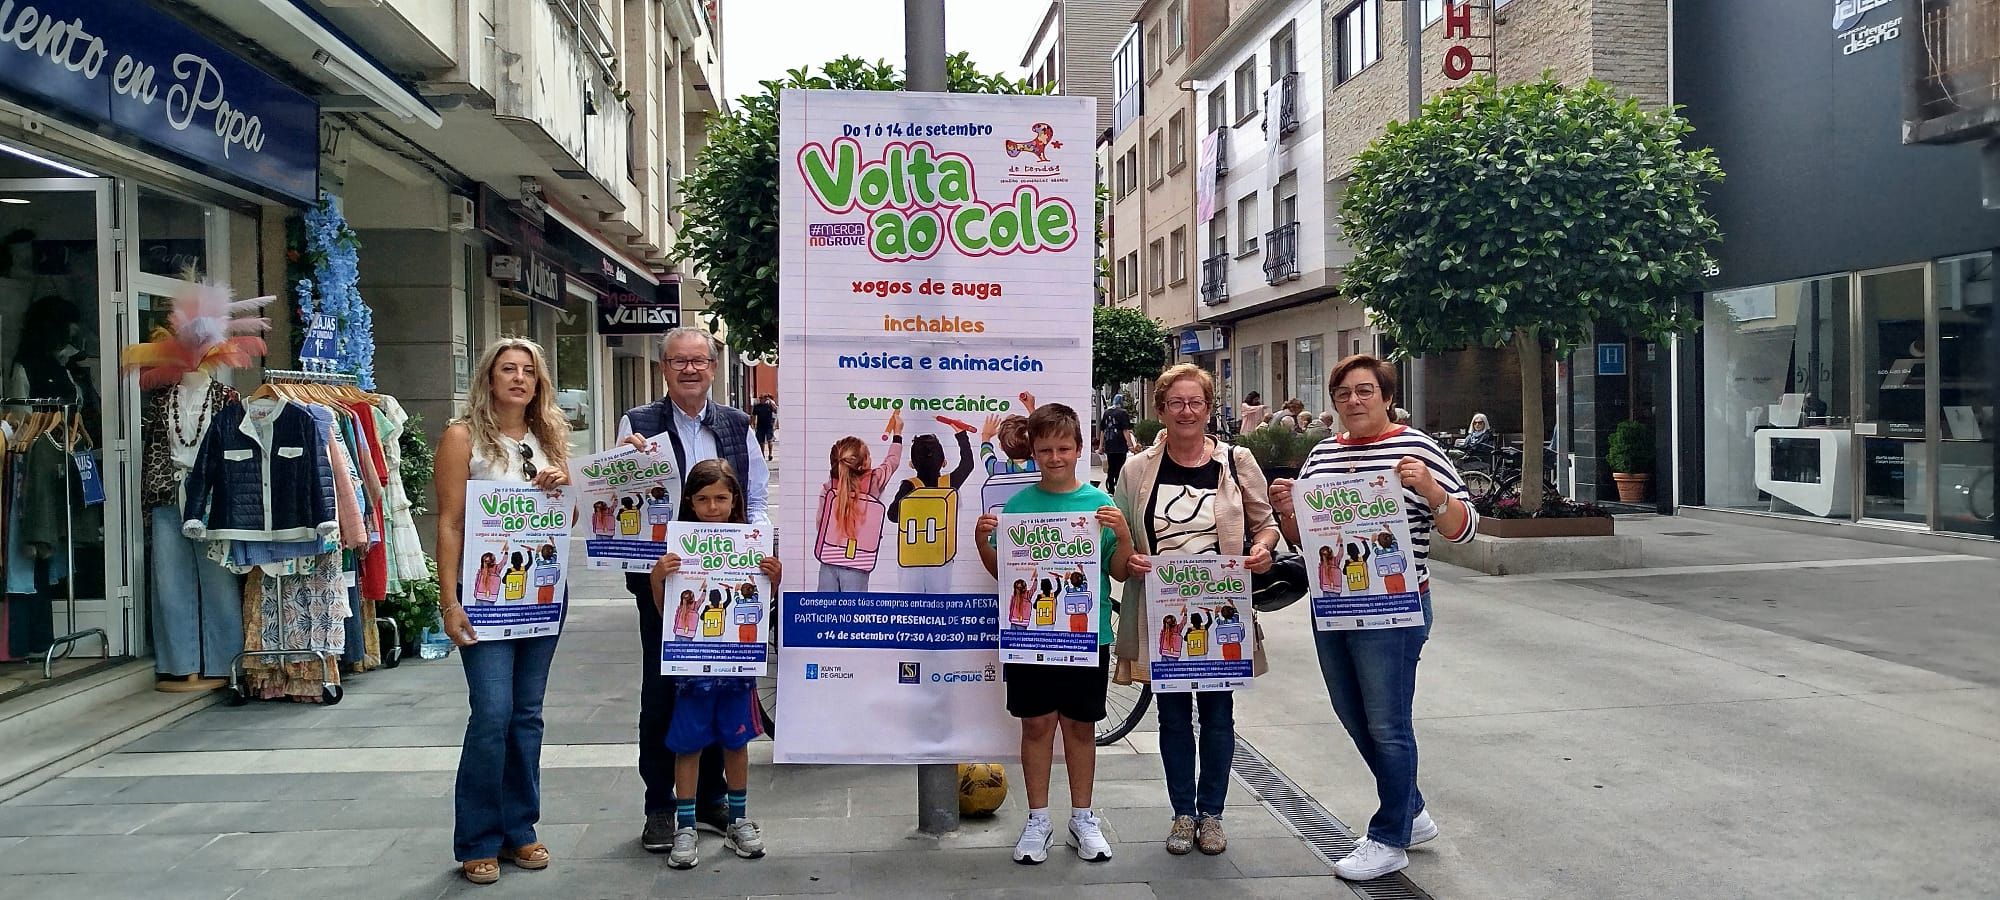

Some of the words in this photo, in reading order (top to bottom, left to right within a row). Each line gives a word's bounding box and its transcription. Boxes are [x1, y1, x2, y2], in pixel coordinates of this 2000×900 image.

[113, 54, 158, 105] en
[166, 53, 266, 160] Popa
[843, 123, 861, 137] Do
[864, 123, 871, 136] 1
[886, 123, 903, 137] 14
[906, 123, 923, 137] de
[925, 123, 993, 138] setembro
[802, 141, 971, 209] Volta
[873, 211, 938, 255] ao
[953, 191, 1071, 251] cole
[852, 279, 912, 298] xogos
[918, 278, 946, 296] de
[951, 281, 1003, 300] auga
[605, 303, 677, 327] Julián
[883, 314, 985, 334] inchables
[838, 351, 913, 370] música
[919, 356, 932, 370] e
[938, 353, 1044, 372] animación
[1604, 347, 1618, 364] H
[846, 393, 904, 411] touro
[909, 395, 1011, 413] mecánico
[582, 459, 637, 478] Volta
[607, 475, 629, 485] ao
[633, 461, 671, 480] cole
[481, 494, 536, 515] Volta
[1305, 488, 1362, 511] Volta
[1332, 508, 1354, 522] ao
[1357, 496, 1397, 518] cole
[503, 516, 525, 531] ao
[530, 509, 564, 528] cole
[681, 534, 734, 554] Volta
[1009, 525, 1061, 546] Volta
[1031, 545, 1052, 559] ao
[1056, 537, 1093, 557] cole
[702, 555, 723, 569] ao
[728, 549, 764, 567] cole
[1158, 565, 1211, 584] Volta
[1180, 584, 1201, 597] ao
[1205, 576, 1243, 593] cole
[799, 597, 837, 608] Consegue
[838, 599, 856, 608] coas
[875, 599, 909, 610] compras
[910, 599, 945, 609] entradas
[945, 600, 964, 610] para
[965, 600, 972, 609] A
[972, 599, 998, 609] FESTA
[794, 613, 838, 624] PARTICIPA
[839, 614, 851, 624] NO
[853, 614, 889, 625] SORTEO
[890, 615, 947, 626] PRESENCIAL
[948, 616, 959, 625] DE
[960, 616, 977, 625] 150
[978, 616, 986, 625] €
[986, 617, 996, 625] en
[816, 632, 823, 640] o
[824, 630, 836, 640] 14
[837, 630, 849, 640] de
[850, 630, 895, 641] setembro
[896, 631, 925, 642] (17:30
[926, 633, 934, 642] A
[934, 632, 965, 643] 20:30)
[967, 633, 979, 642] na
[980, 631, 1000, 642] Praz
[829, 672, 854, 680] GALICIA
[931, 672, 941, 682] O
